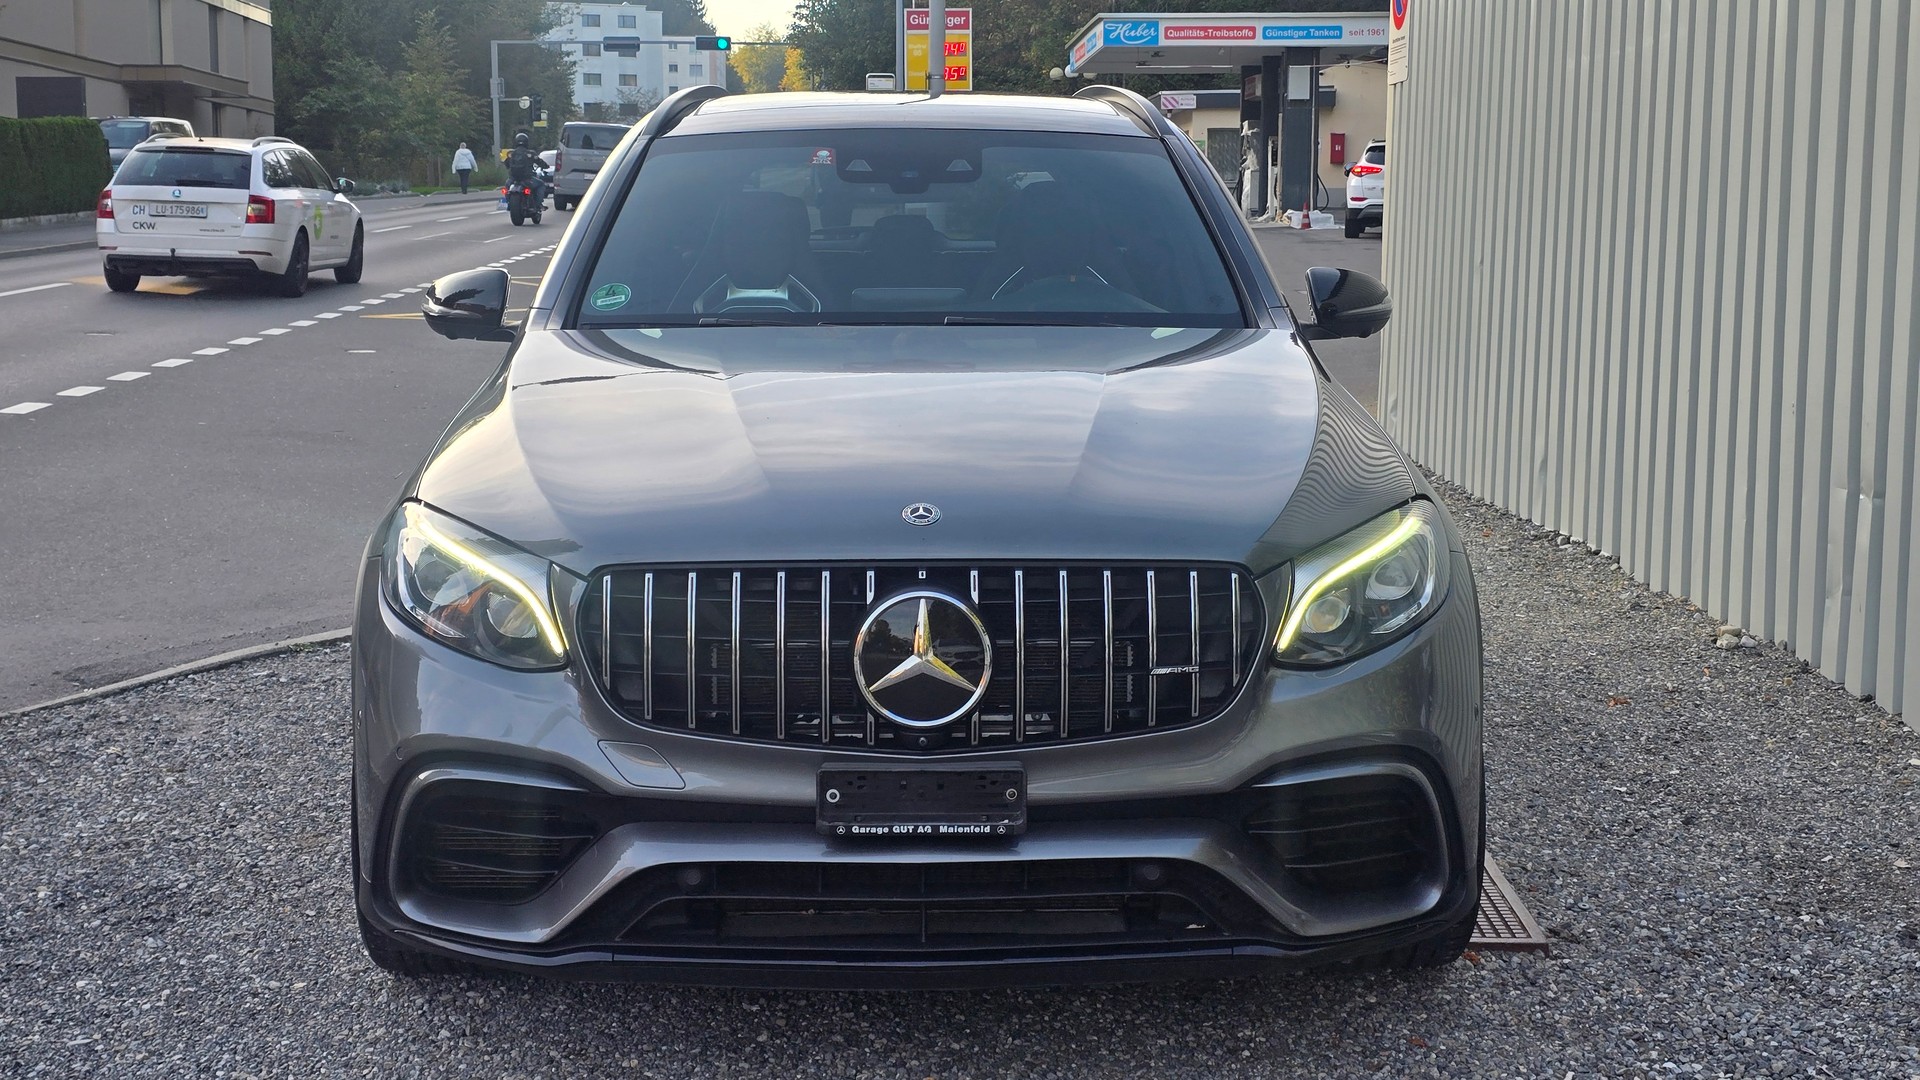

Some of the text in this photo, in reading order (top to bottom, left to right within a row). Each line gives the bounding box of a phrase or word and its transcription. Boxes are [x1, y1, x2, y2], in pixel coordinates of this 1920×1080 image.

[910, 14, 966, 27] Güiger
[1104, 22, 1158, 44] Huber
[1167, 29, 1254, 38] Qualitäts-Treibstoffe
[1265, 28, 1340, 39] Günstiger Tanken
[1348, 28, 1386, 37] seit 1961
[132, 204, 146, 215] CH
[132, 221, 157, 231] CKW
[851, 825, 991, 835] Garage GUT AG Maienfeld
